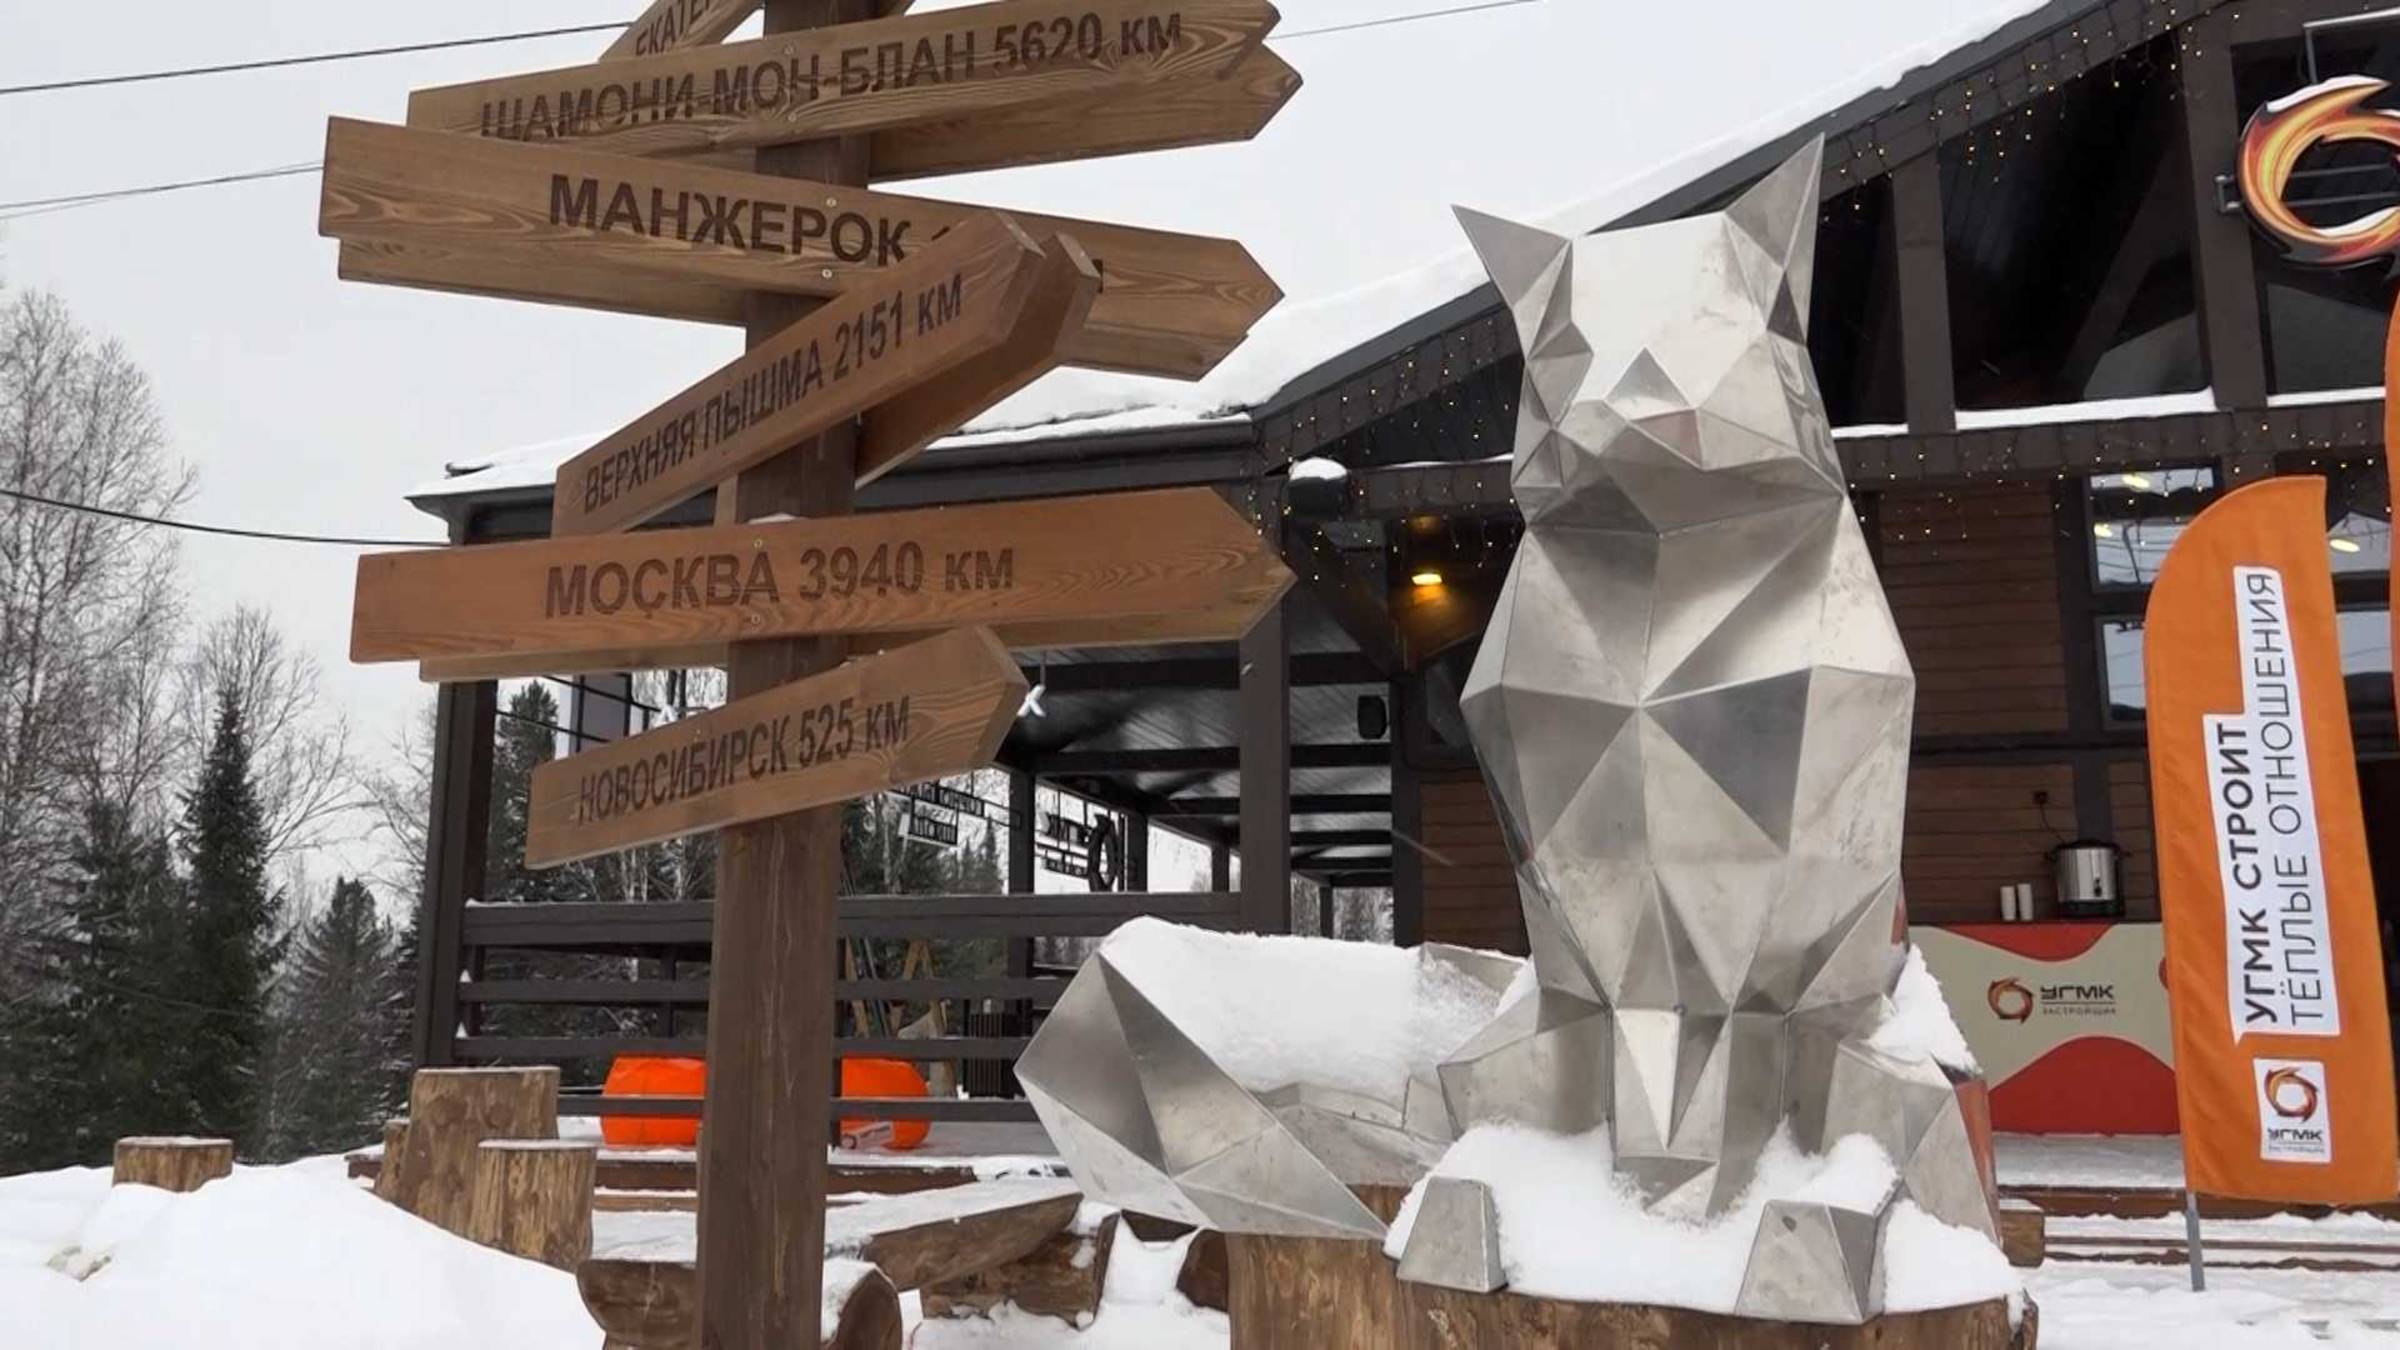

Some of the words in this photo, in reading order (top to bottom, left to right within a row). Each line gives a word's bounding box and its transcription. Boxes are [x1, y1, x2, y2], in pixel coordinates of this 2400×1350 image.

[480, 32, 975, 142] ШАМОНИ-МОН-БЛАН
[993, 12, 1102, 73] 5620
[635, 0, 710, 56] ЕКАТЕ
[550, 173, 911, 267] МАНЖЕРОК
[584, 414, 695, 513] ВЕРХНЯЯ
[703, 338, 823, 451] ПЫШМА
[834, 289, 903, 381] 2151
[545, 550, 780, 618] МОСКВА
[800, 541, 925, 600] 3940
[577, 714, 788, 826] НОВОСИБИРСК
[799, 697, 854, 768] 525
[2246, 573, 2301, 835] ОТНОШЕНИЯ
[2216, 722, 2262, 890] СТРОИТ
[2040, 984, 2115, 1000] УГМК
[2238, 908, 2278, 1023] УГМК
[2273, 854, 2324, 1026] ТЁПЛЫЕ
